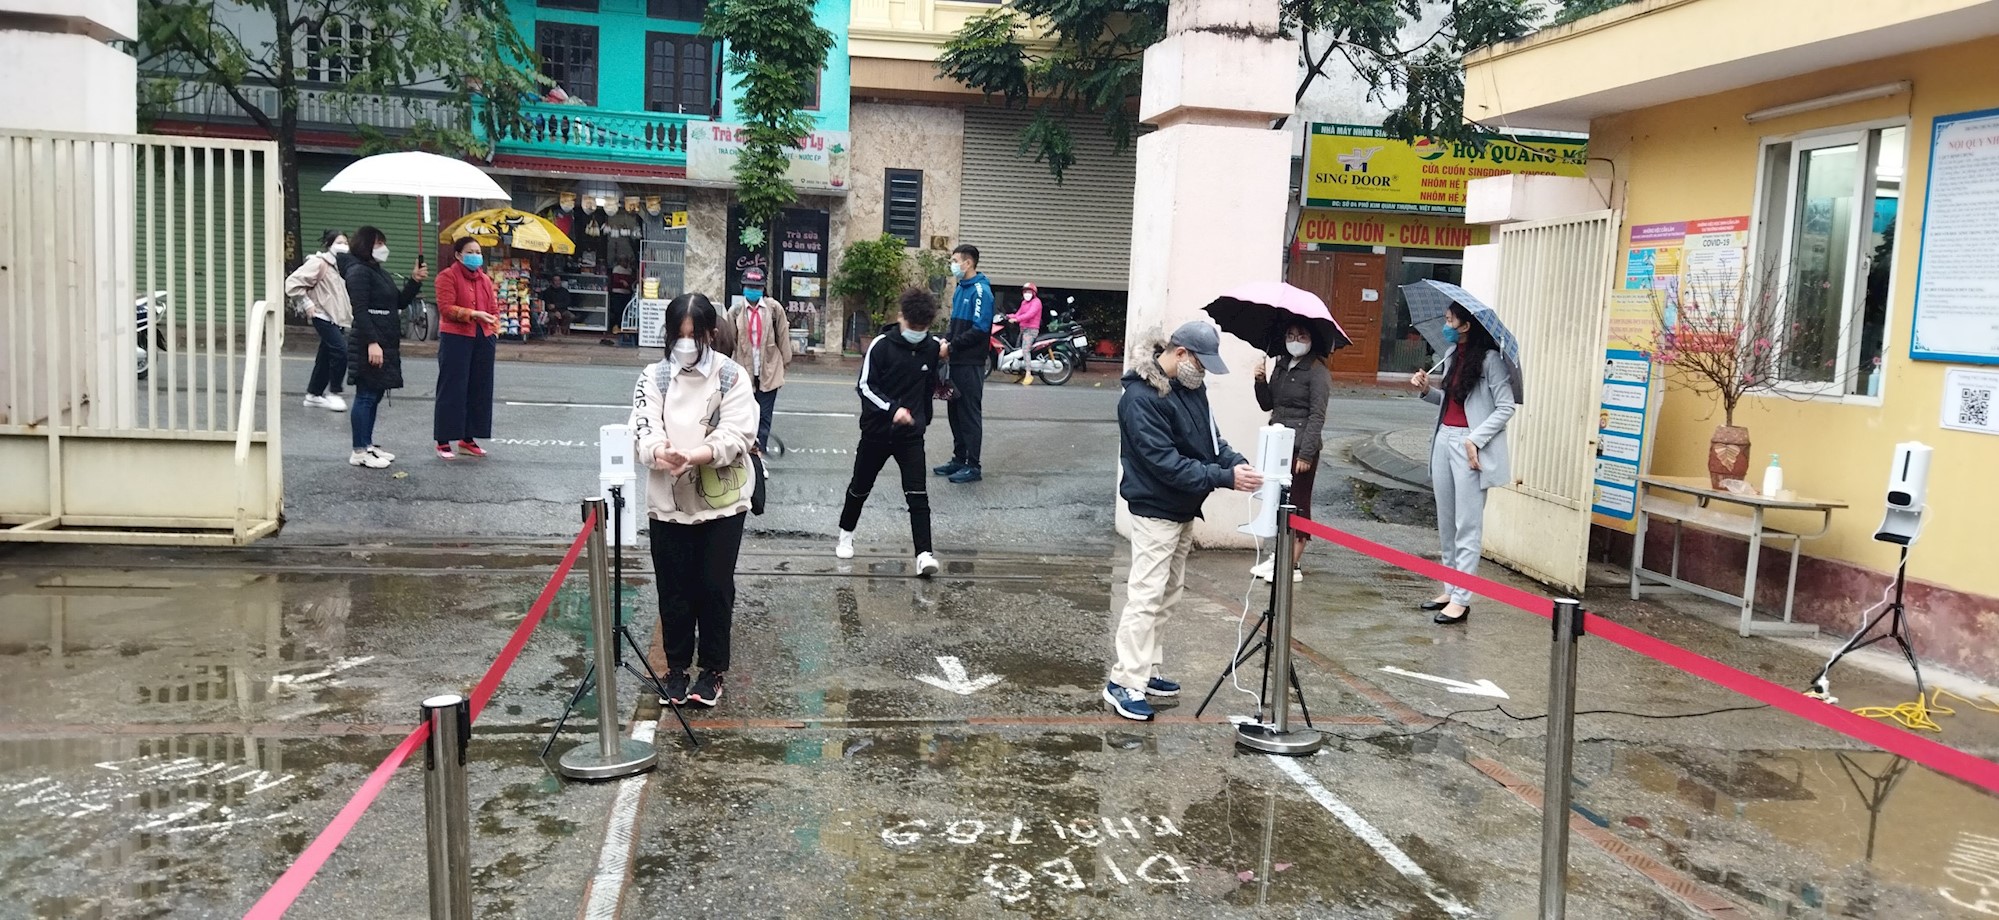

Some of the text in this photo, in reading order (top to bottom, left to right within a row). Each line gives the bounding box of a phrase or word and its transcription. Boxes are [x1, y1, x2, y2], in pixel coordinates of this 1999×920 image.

[711, 126, 732, 142] Trà
[1336, 125, 1352, 136] MÁY
[810, 133, 824, 152] Ly
[1422, 162, 1439, 174] CỬA
[1442, 163, 1465, 175] CUỐN
[1315, 172, 1391, 187] SING DOOR
[1306, 213, 1337, 241] CỬA
[1342, 215, 1385, 243] CUỐN
[1400, 217, 1430, 245] CỬA
[1435, 222, 1473, 247] KÍNH
[1702, 238, 1730, 248] COVID-19
[788, 300, 817, 313] BIA
